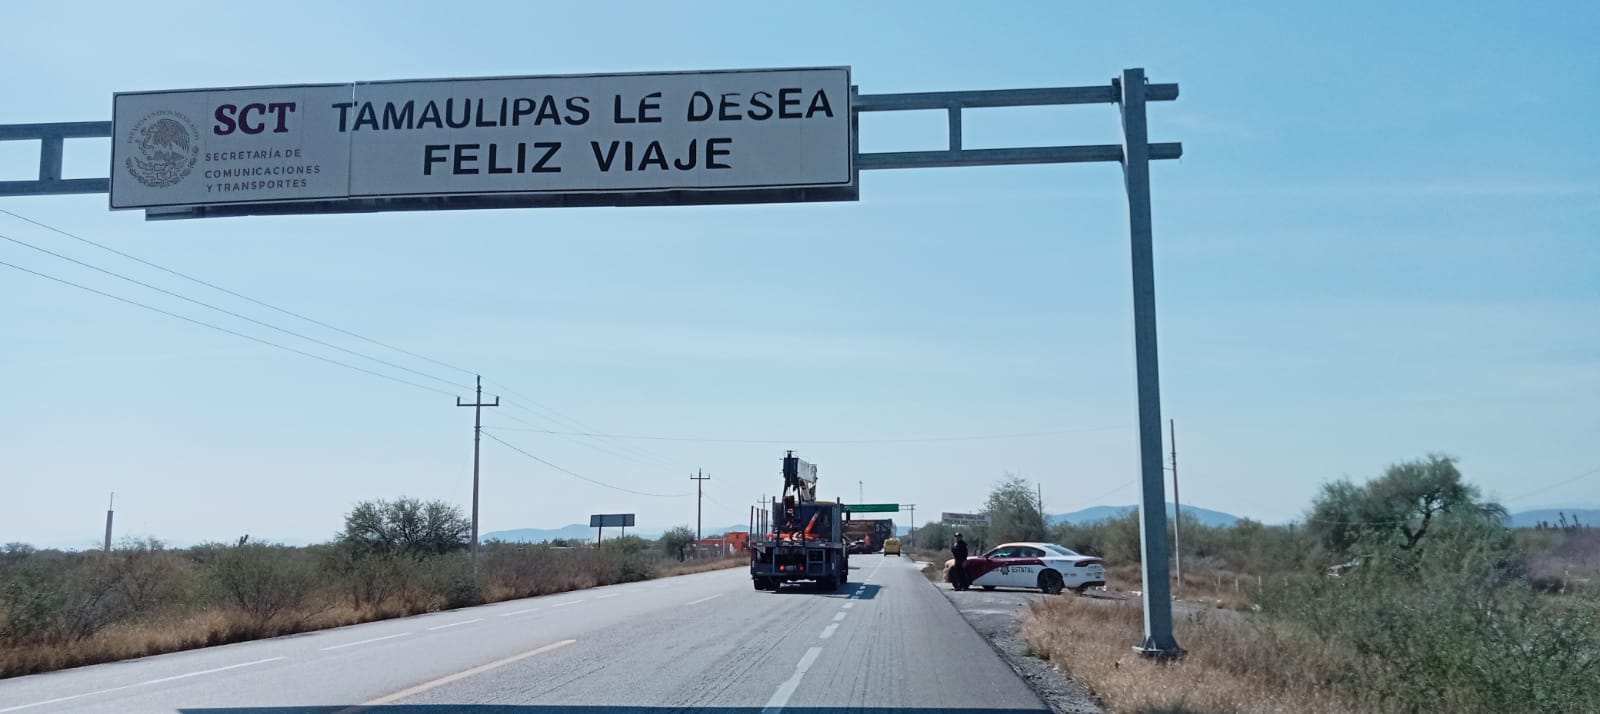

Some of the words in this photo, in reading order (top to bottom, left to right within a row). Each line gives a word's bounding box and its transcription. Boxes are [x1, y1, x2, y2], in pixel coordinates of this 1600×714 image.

[213, 101, 296, 136] SCT
[332, 95, 590, 132] TAMAULIPAS
[613, 91, 663, 125] LE
[686, 87, 835, 122] DESEA
[205, 148, 281, 162] SECRETARÍA
[285, 148, 302, 158] DE
[423, 141, 563, 176] FELIZ
[591, 137, 734, 172] VIAJE
[204, 164, 321, 179] COMUNICACIONES
[206, 184, 214, 193] Y
[216, 178, 307, 193] TRANSPORTES
